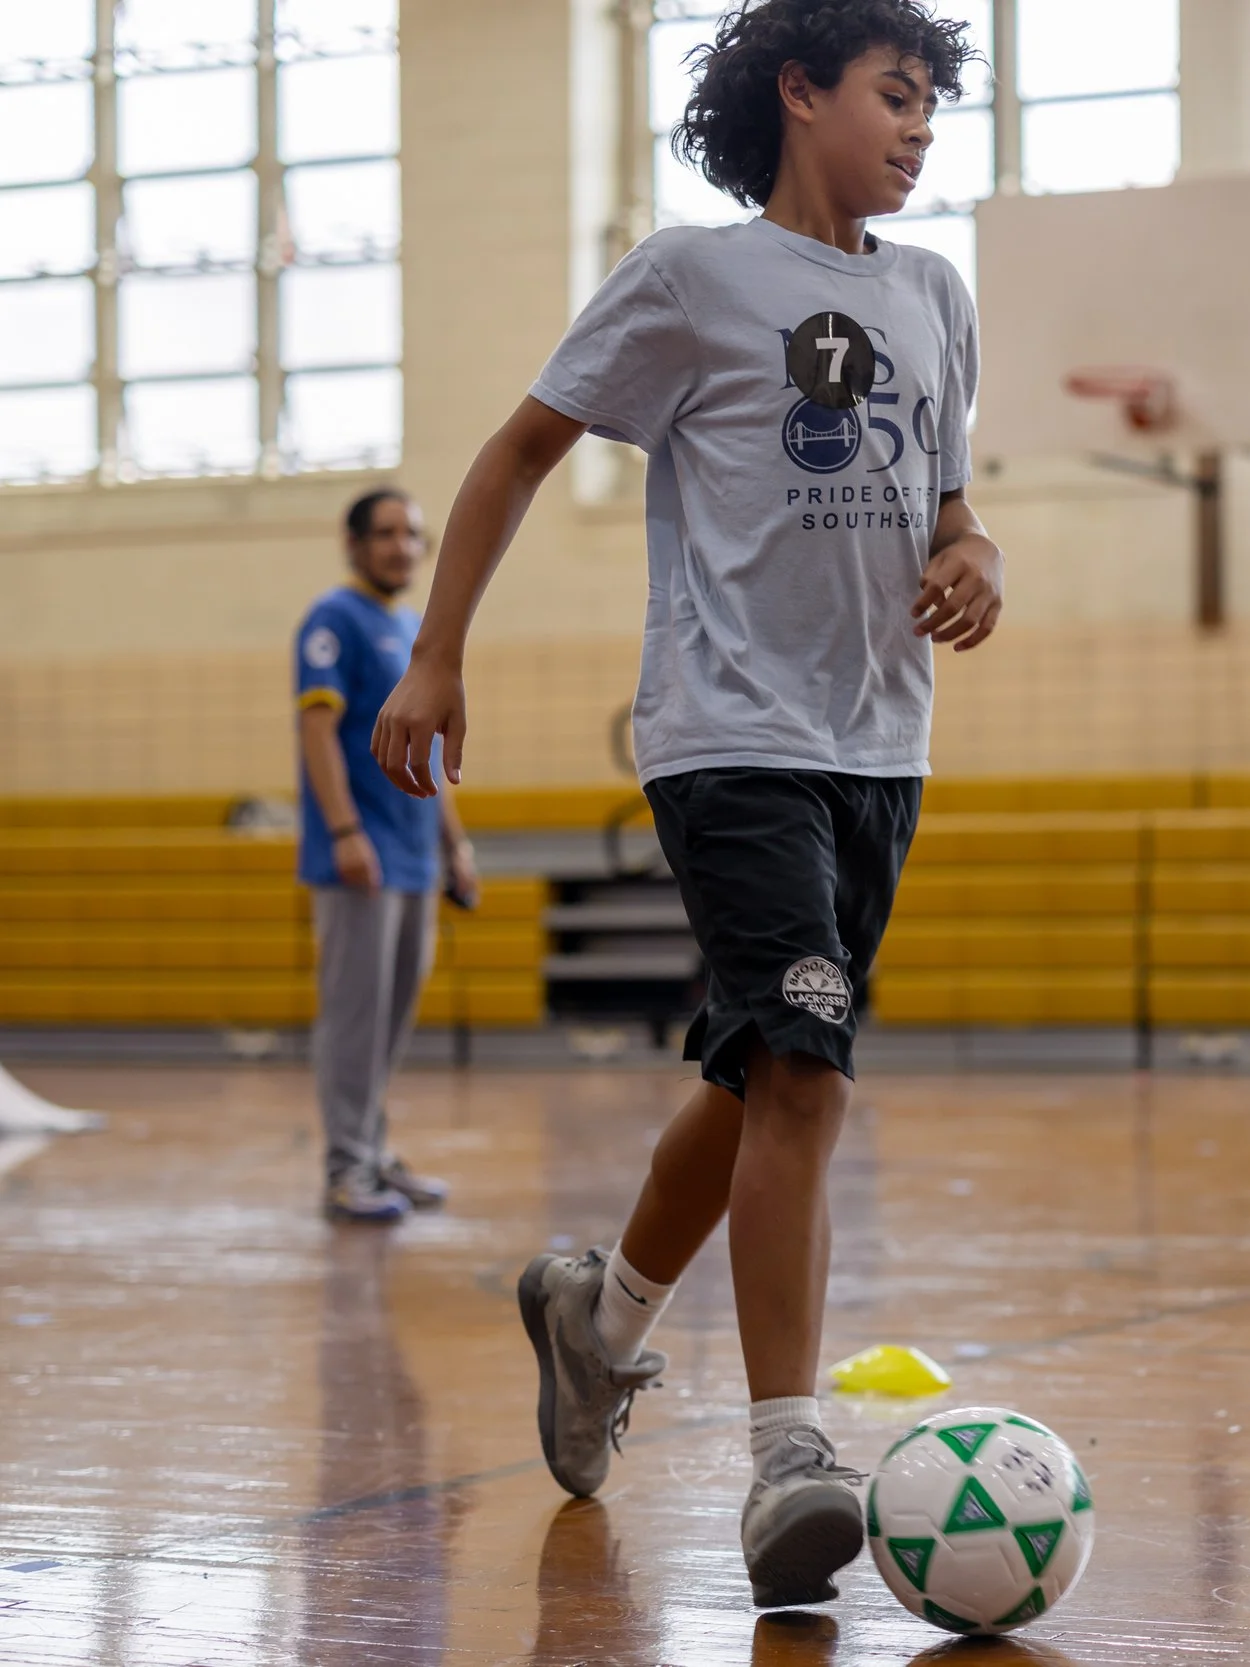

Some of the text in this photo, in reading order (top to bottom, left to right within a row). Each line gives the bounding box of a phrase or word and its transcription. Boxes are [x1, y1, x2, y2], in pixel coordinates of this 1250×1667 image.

[816, 338, 850, 383] 7
[787, 486, 872, 505] PRIDE
[883, 486, 910, 503] OF
[802, 511, 927, 530] SOUTHSID
[789, 992, 847, 1008] LACROSSE
[807, 1003, 836, 1016] CLUB
